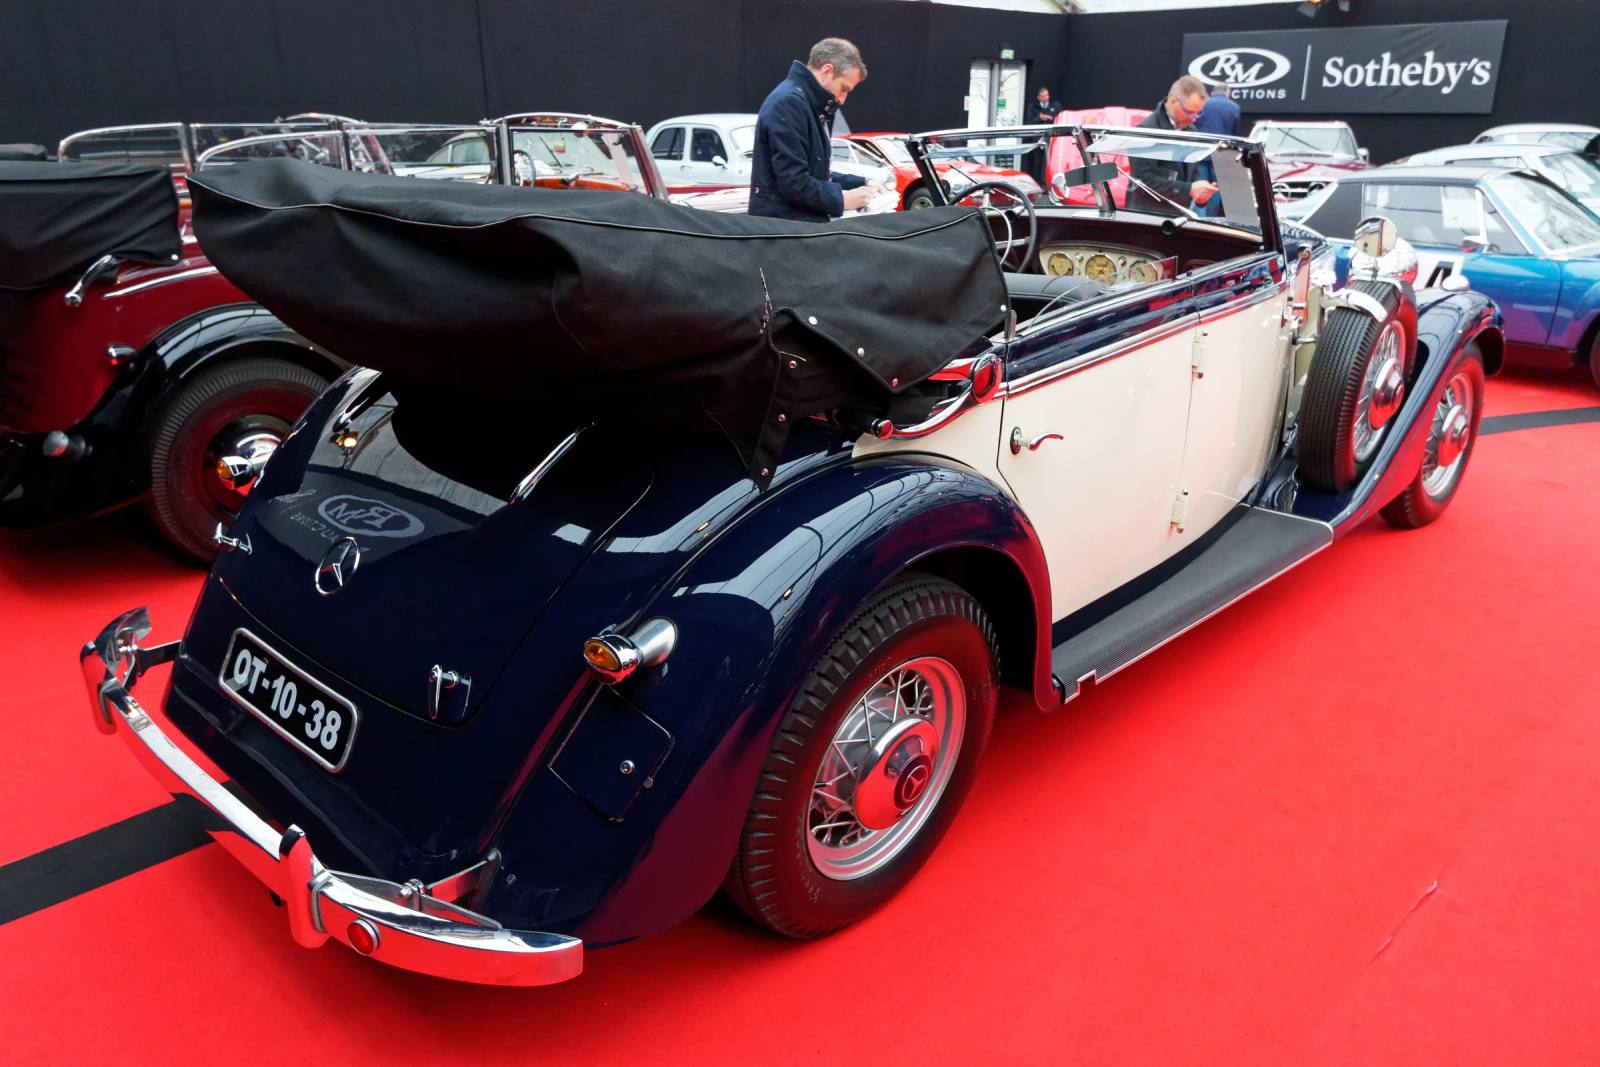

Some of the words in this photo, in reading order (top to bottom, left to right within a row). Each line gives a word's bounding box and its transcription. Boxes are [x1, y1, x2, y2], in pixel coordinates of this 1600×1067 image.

[1209, 53, 1264, 83] RM
[1322, 50, 1491, 94] Sotheby's
[1231, 88, 1287, 100] CTIONS
[233, 648, 342, 751] OT-10-38
